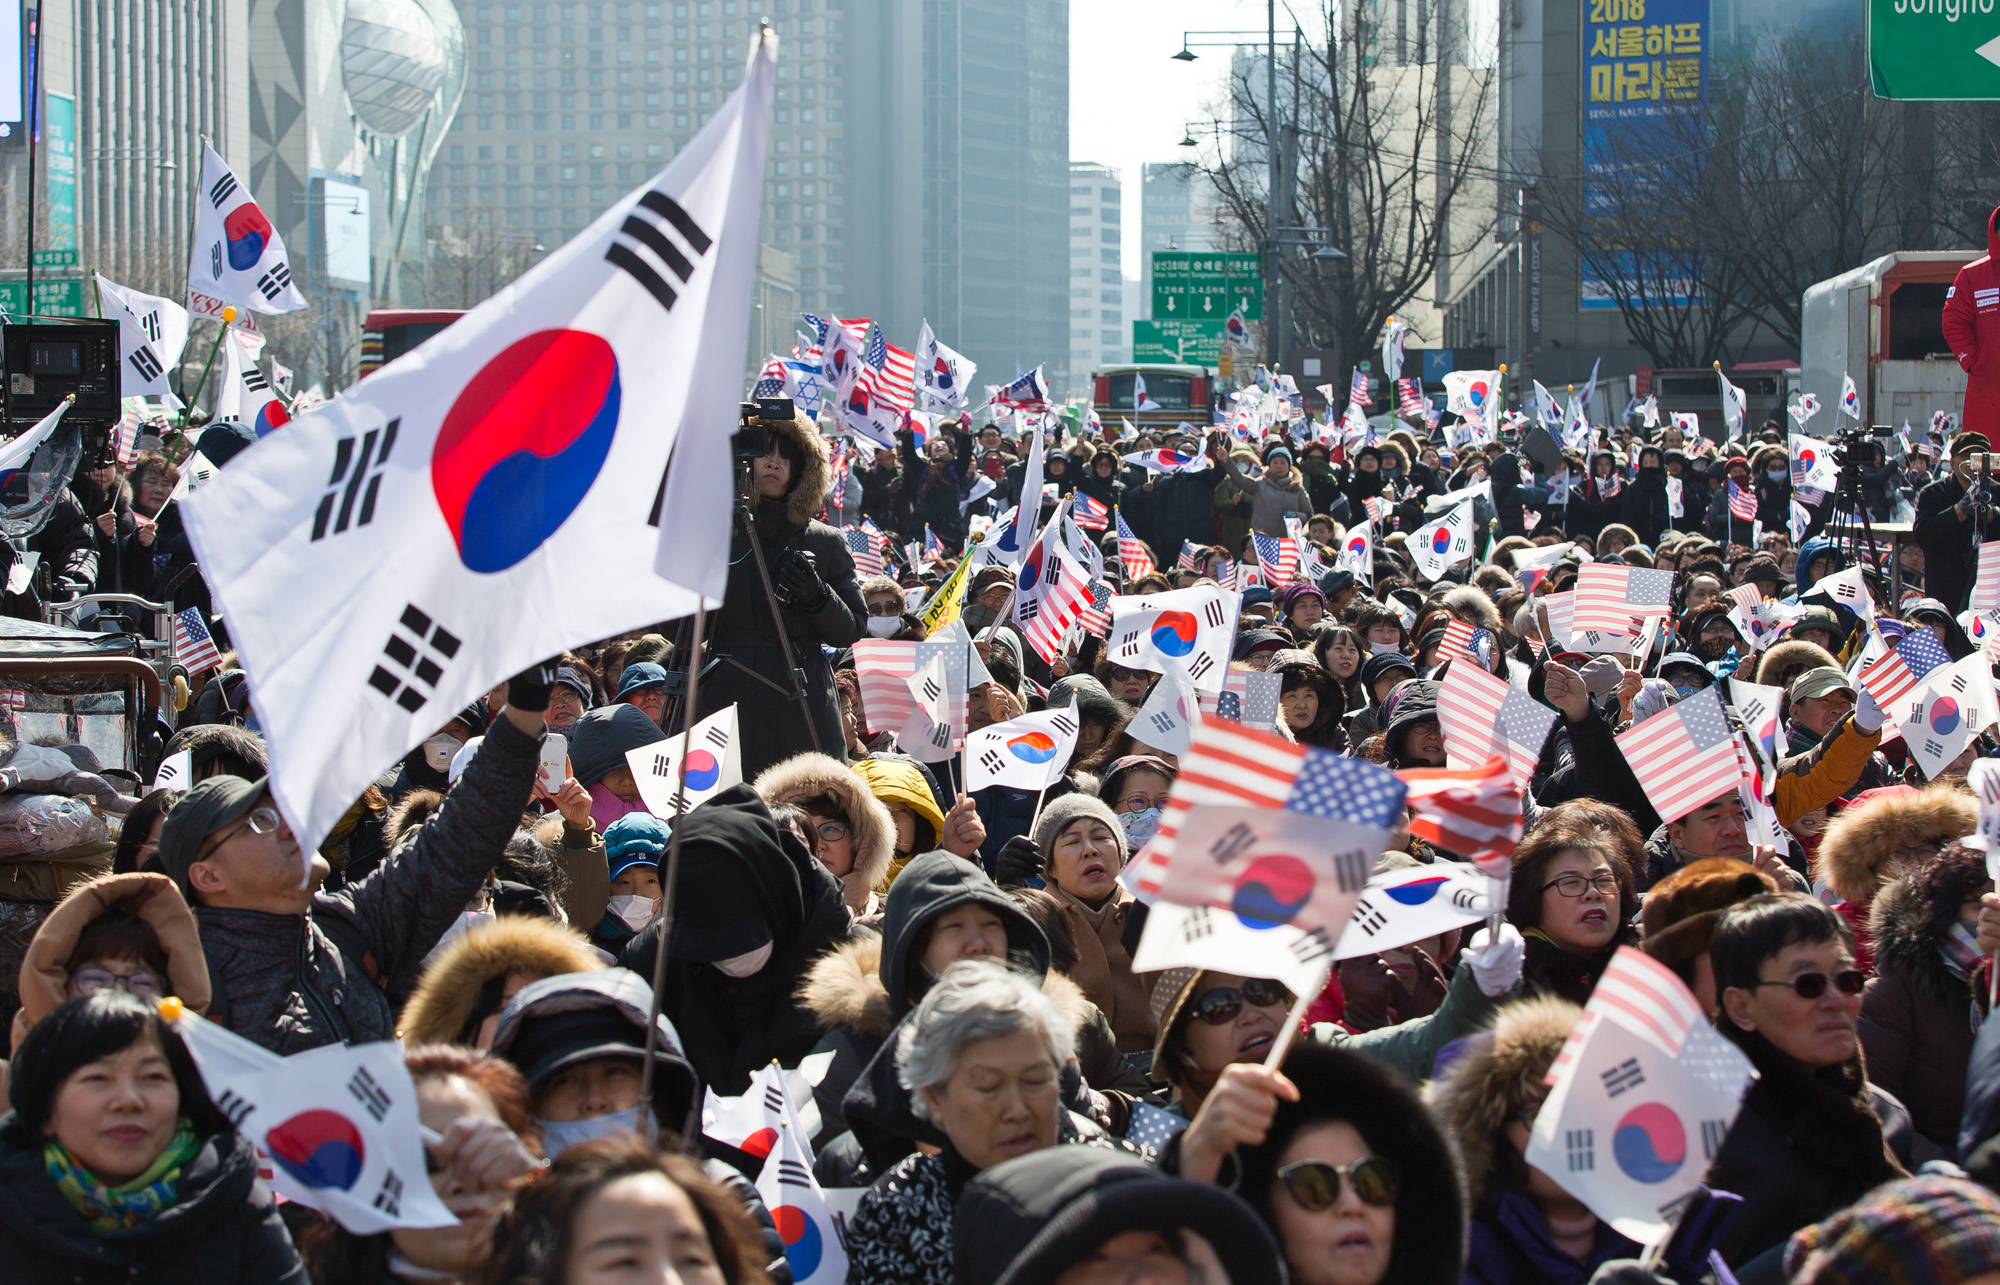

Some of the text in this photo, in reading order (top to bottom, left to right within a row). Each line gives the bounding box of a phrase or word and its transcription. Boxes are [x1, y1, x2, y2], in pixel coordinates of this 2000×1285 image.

[1590, 0, 1645, 23] 2018
[1590, 23, 1701, 58] 서울하프
[1591, 58, 1700, 103] 마라톤
